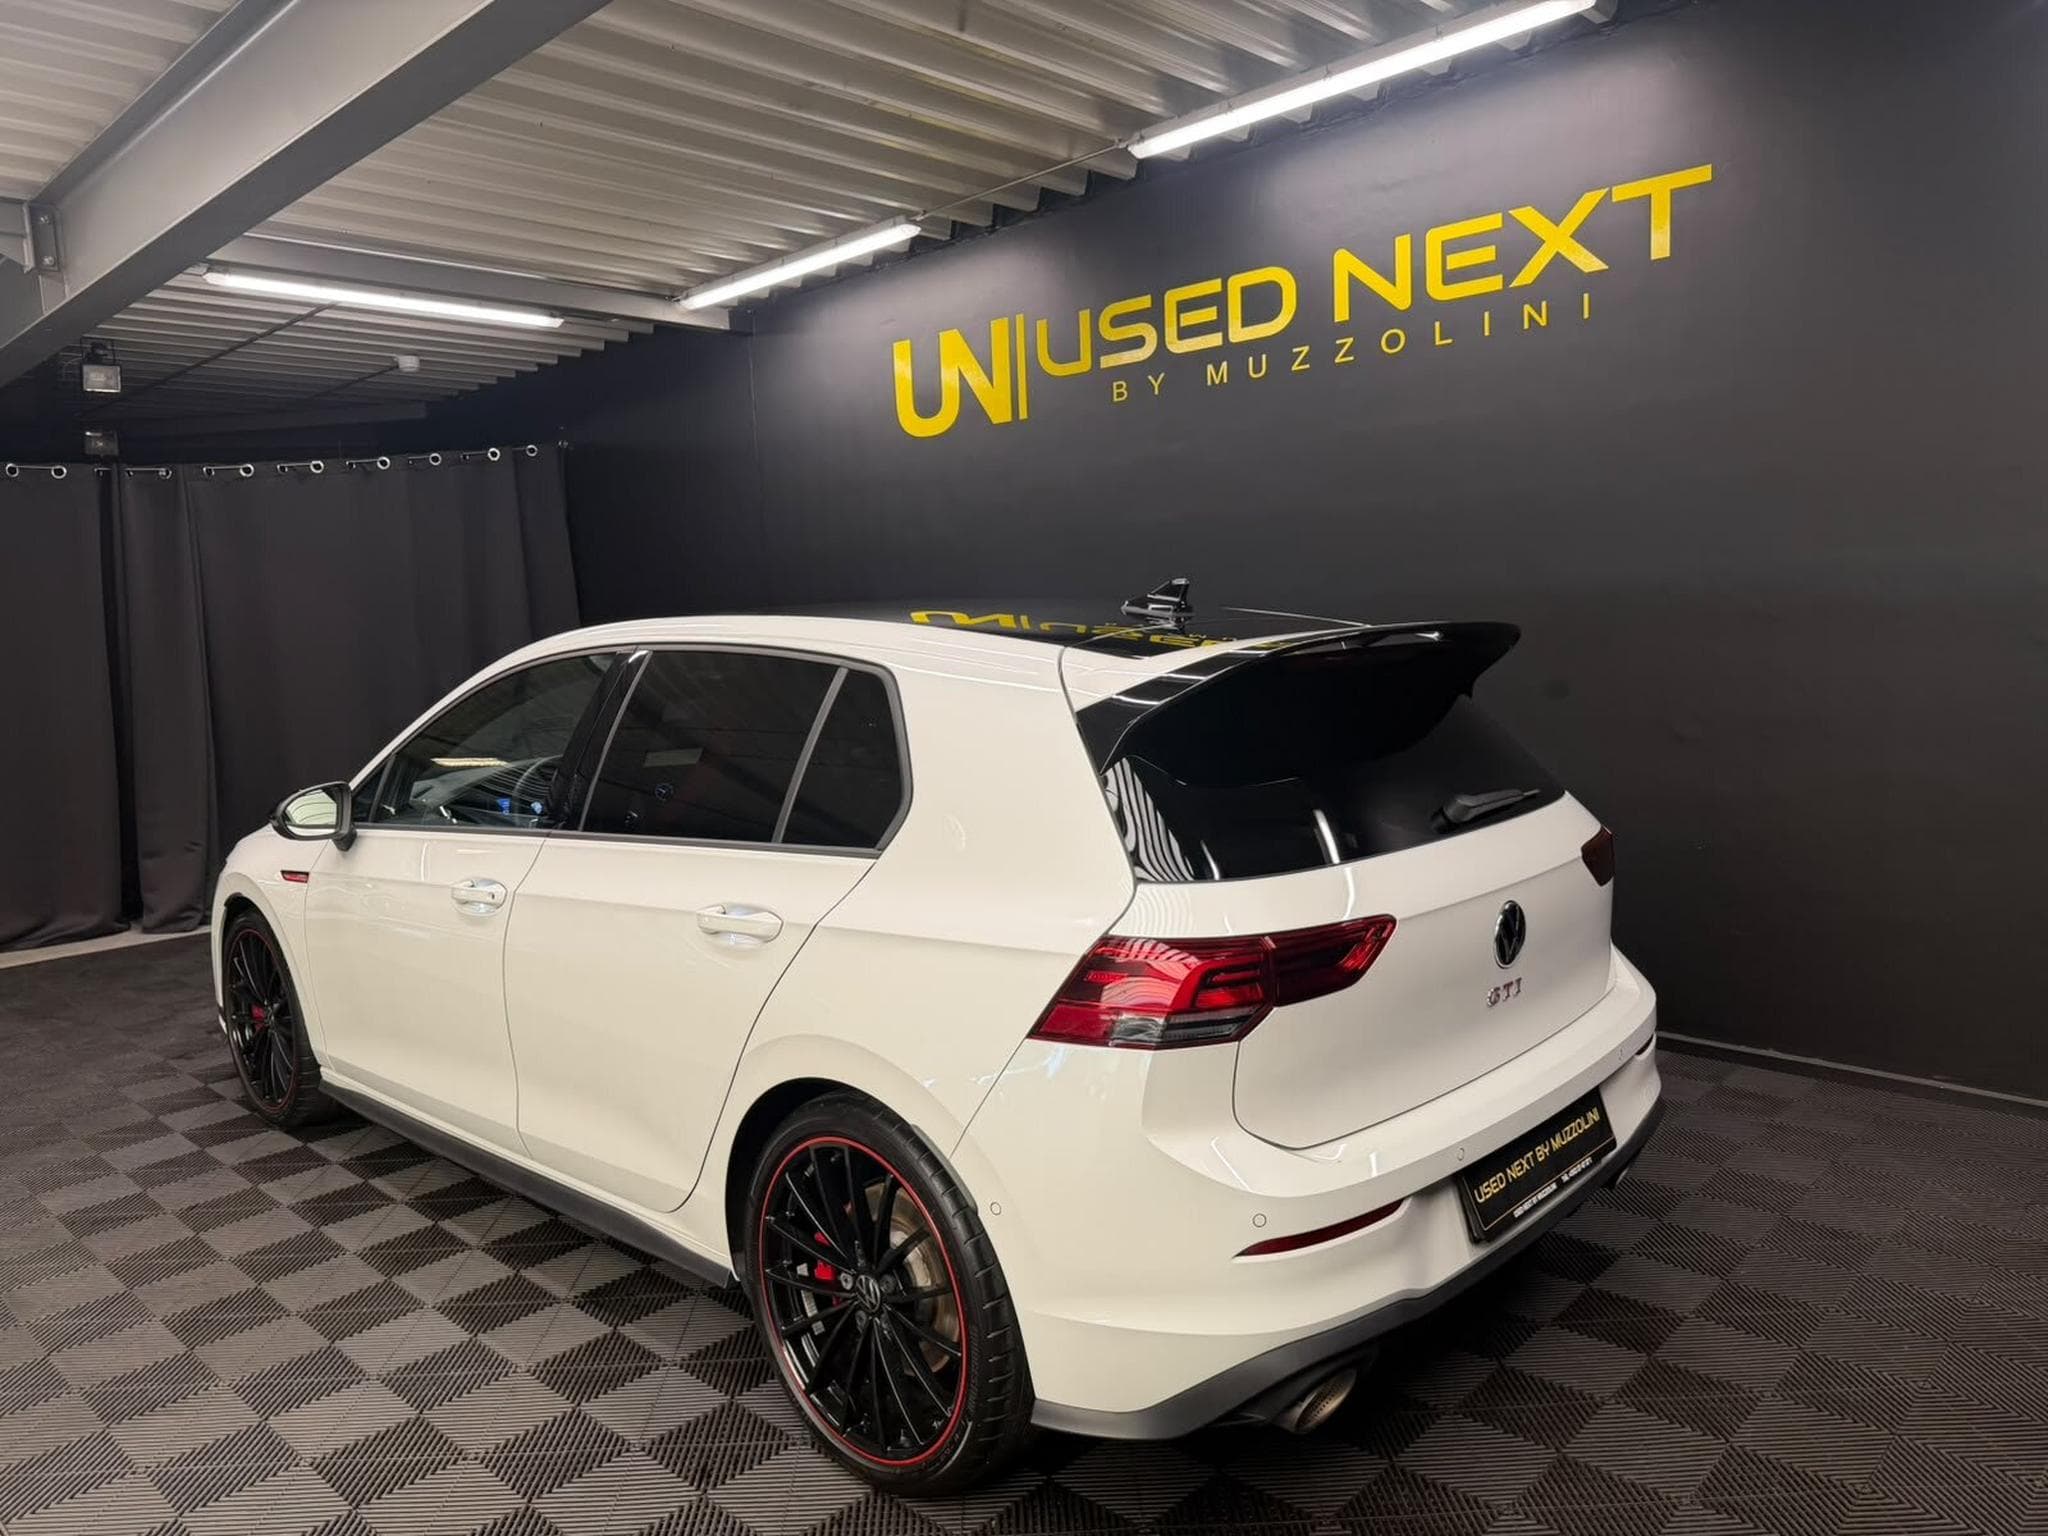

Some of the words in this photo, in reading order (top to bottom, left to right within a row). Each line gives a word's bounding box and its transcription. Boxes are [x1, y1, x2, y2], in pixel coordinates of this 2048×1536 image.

[1034, 266, 1302, 380] USED
[1332, 163, 1713, 324] NEXT
[1110, 376, 1166, 406] BY
[1206, 292, 1595, 388] MUZZOLINI
[1487, 977, 1522, 1007] GTI
[1473, 1172, 1507, 1204] USED
[1506, 1151, 1536, 1183] NEXT
[1534, 1140, 1551, 1162] BY
[1551, 1108, 1600, 1151] MUZZOLINI
